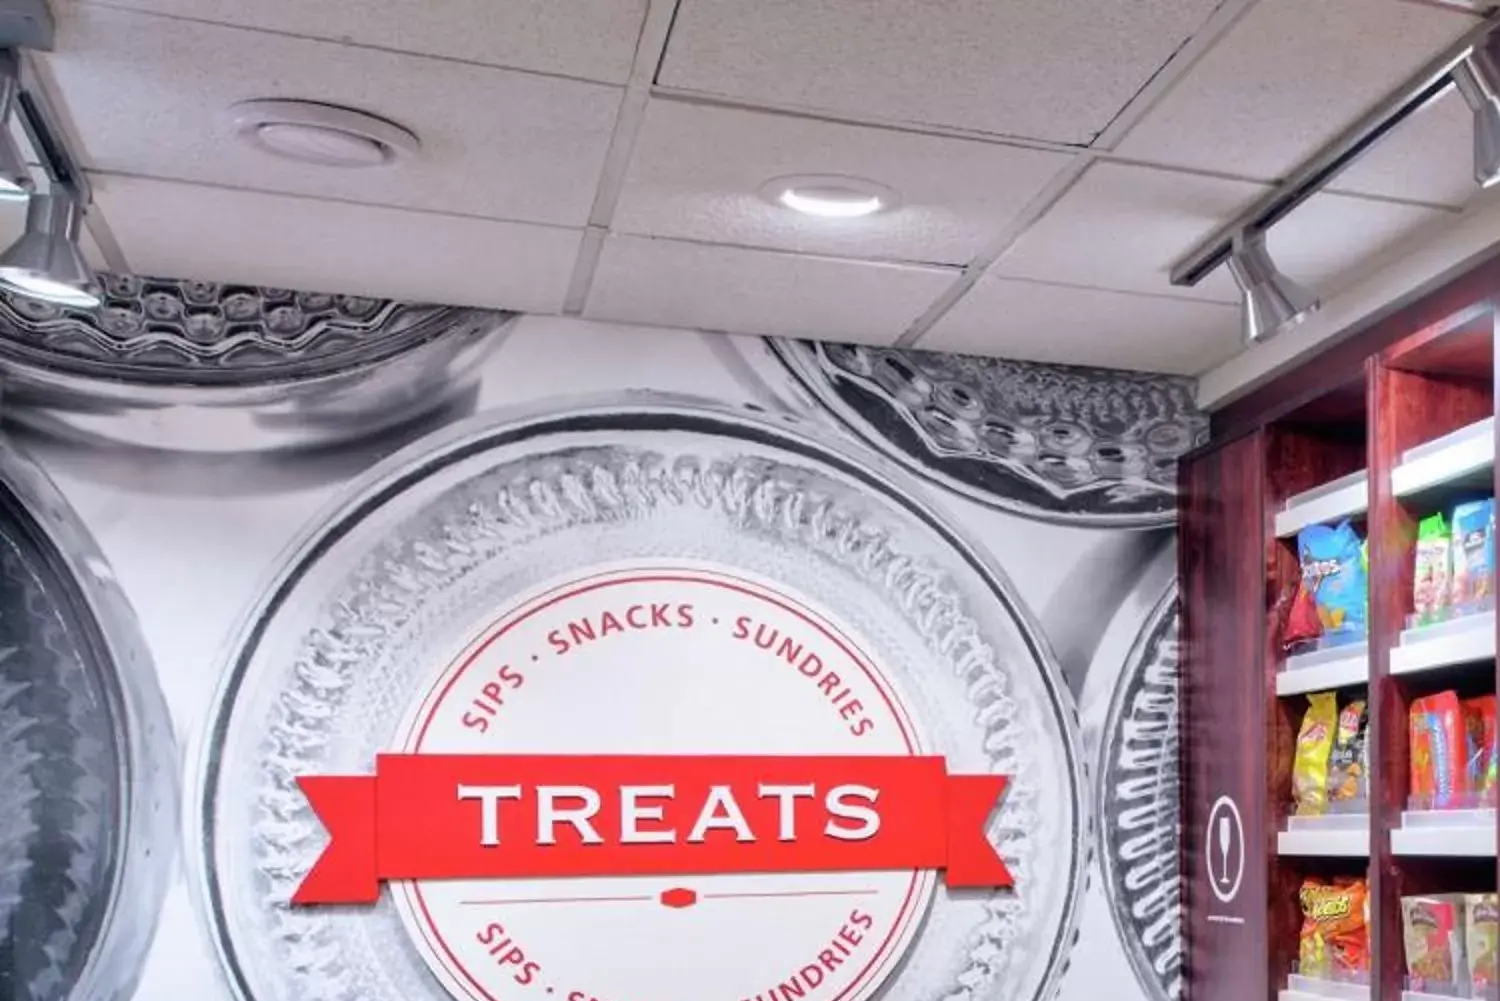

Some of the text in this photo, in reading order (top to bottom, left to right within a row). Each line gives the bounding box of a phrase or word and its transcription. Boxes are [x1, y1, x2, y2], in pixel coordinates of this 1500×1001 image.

[461, 602, 875, 738] SIPS SNACKS SUNDRIES
[456, 783, 882, 847] TREATS
[475, 922, 541, 986] SIPS
